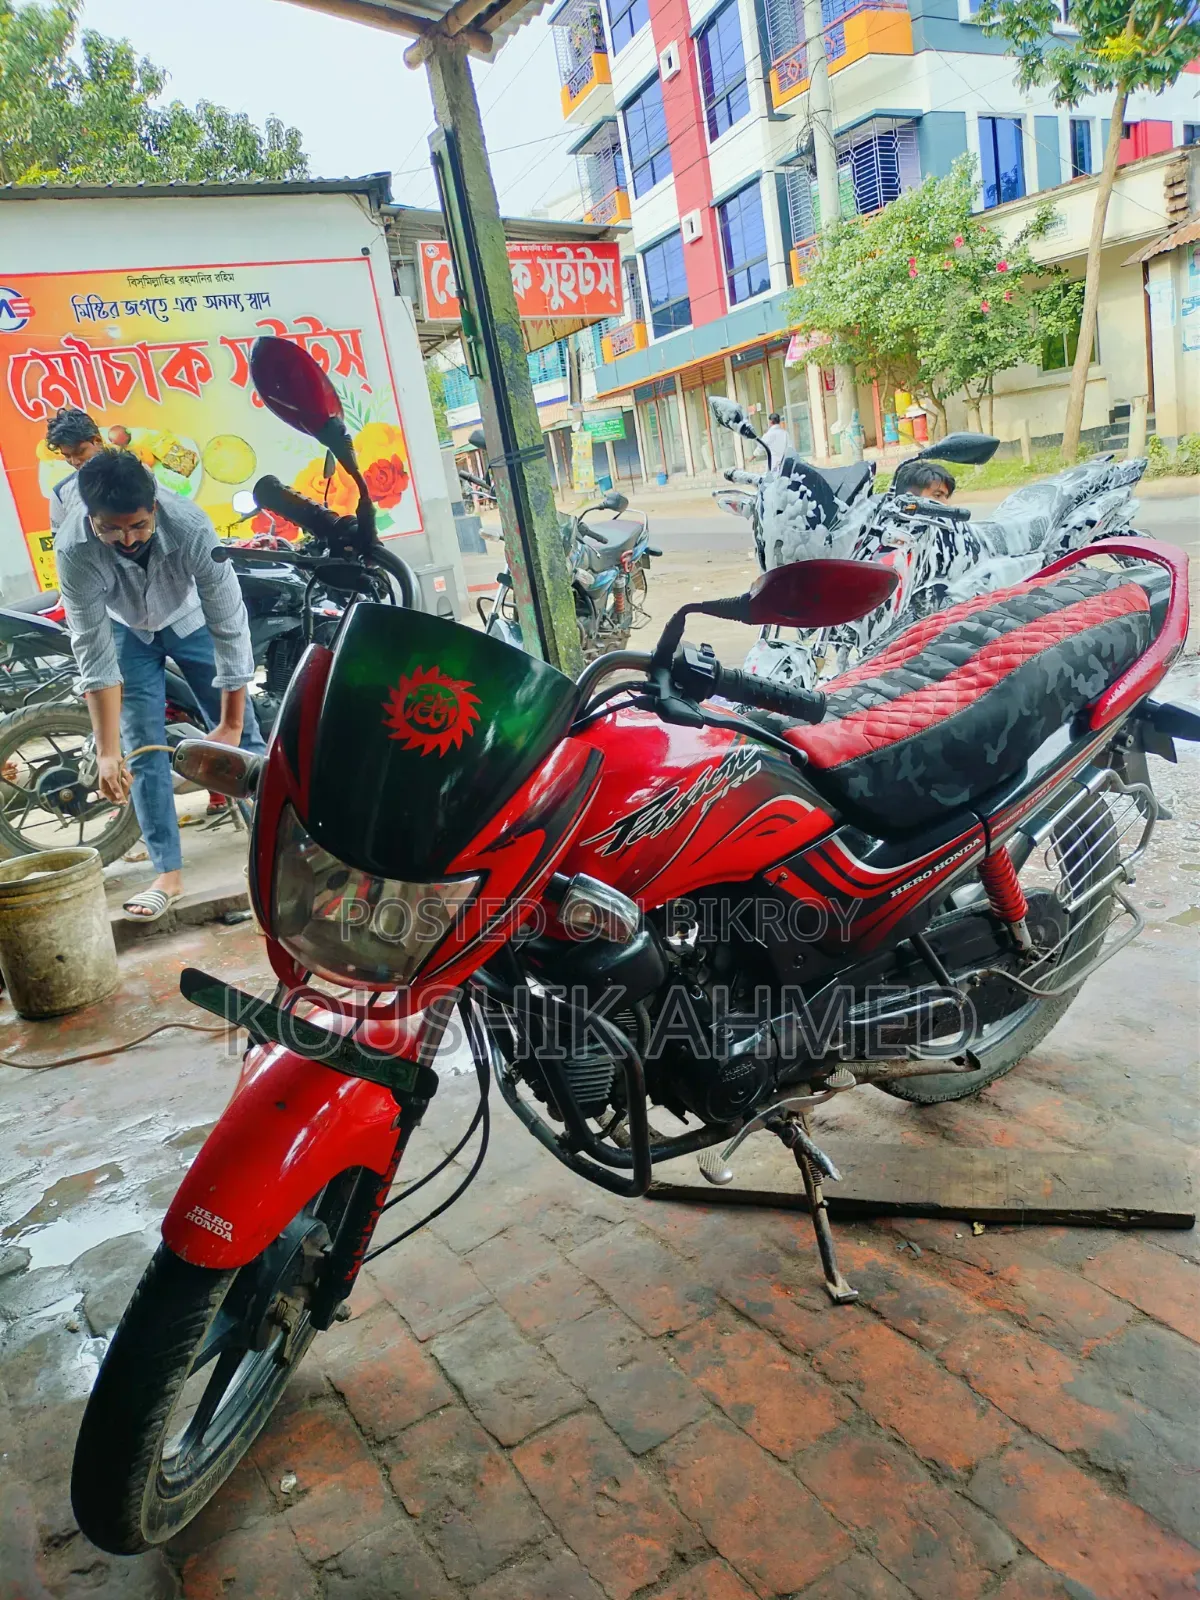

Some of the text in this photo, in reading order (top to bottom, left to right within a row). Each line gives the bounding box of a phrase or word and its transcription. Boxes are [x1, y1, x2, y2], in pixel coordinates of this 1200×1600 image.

[214, 270, 235, 283] রহিম
[71, 292, 271, 323] মিষ্টির জগতে এক অনন্য স্বাদ
[8, 334, 213, 421] মৌচাক
[579, 744, 760, 857] Passion
[701, 760, 762, 812] PRO
[890, 838, 982, 898] HERO HONDA
[184, 1211, 233, 1242] HONDA
[193, 1205, 233, 1231] HERO
